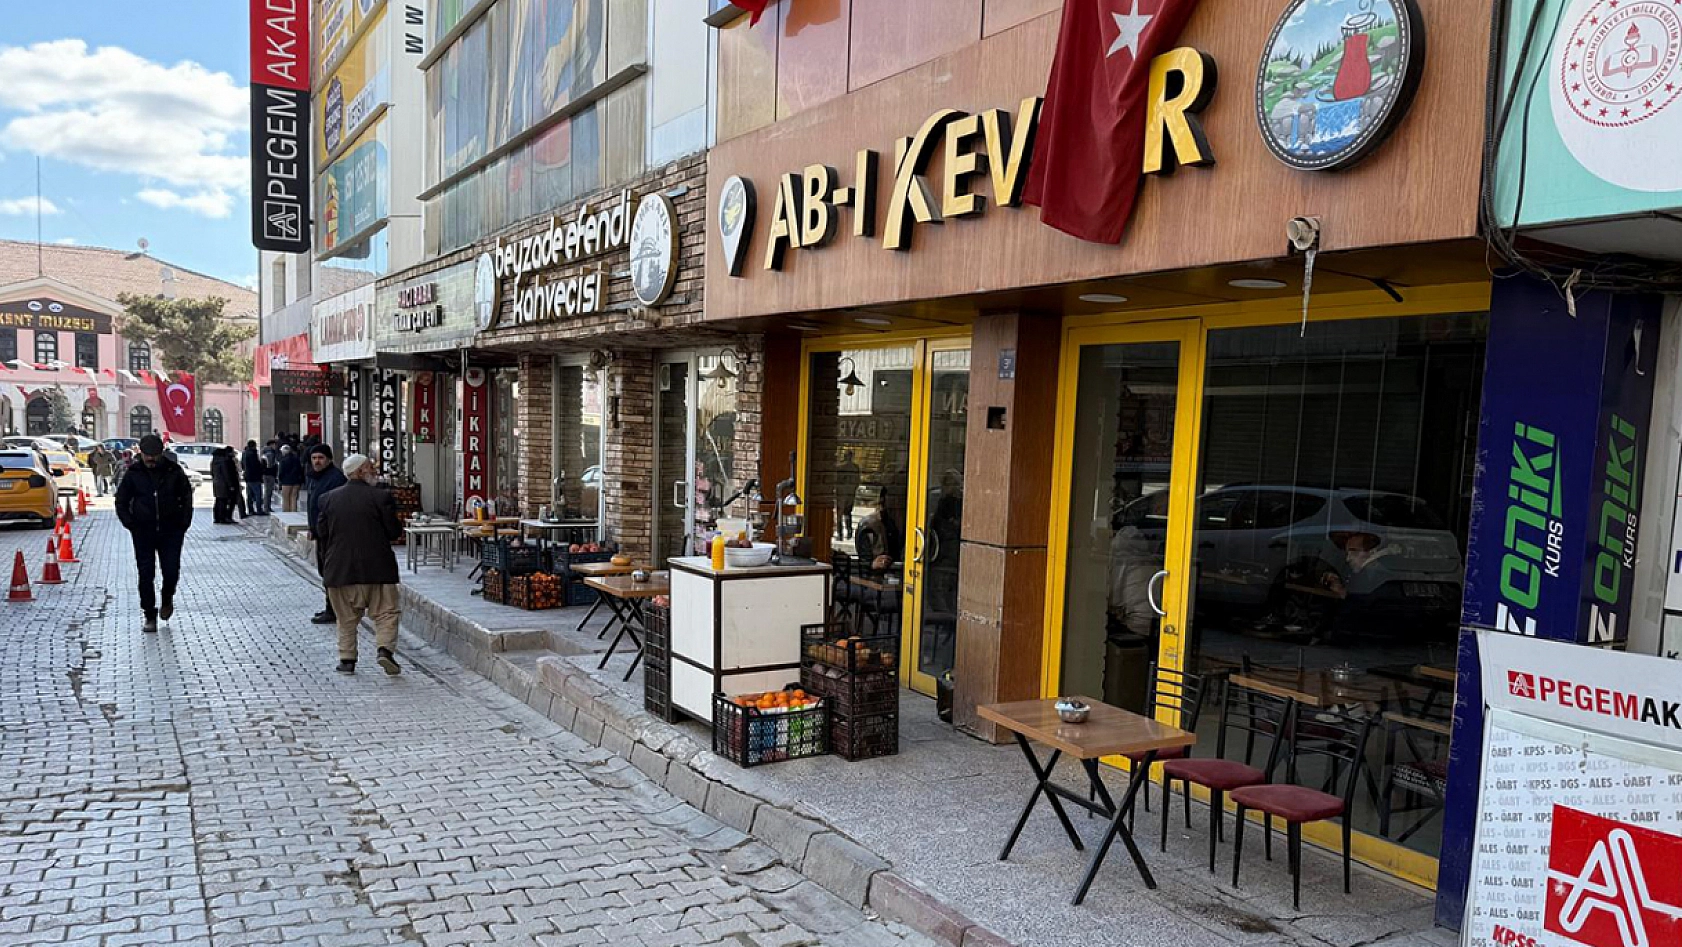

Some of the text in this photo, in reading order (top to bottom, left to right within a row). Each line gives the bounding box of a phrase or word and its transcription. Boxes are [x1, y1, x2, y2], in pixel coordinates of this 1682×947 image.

[266, 89, 298, 200] PEGEM
[1622, 513, 1638, 569] KURS
[1544, 520, 1564, 578] KURS
[1524, 744, 1546, 757] KPSS
[1496, 778, 1518, 790] ÖABT
[1529, 779, 1552, 790] KPSS
[1560, 778, 1580, 789] DGS
[1589, 777, 1614, 788] ALES
[1631, 808, 1660, 822] ÖABT
[1506, 842, 1529, 855] ÖABT
[1484, 875, 1534, 888] ALES ÖABT
[1489, 906, 1509, 919] ALES
[1517, 906, 1541, 921] ÖABT
